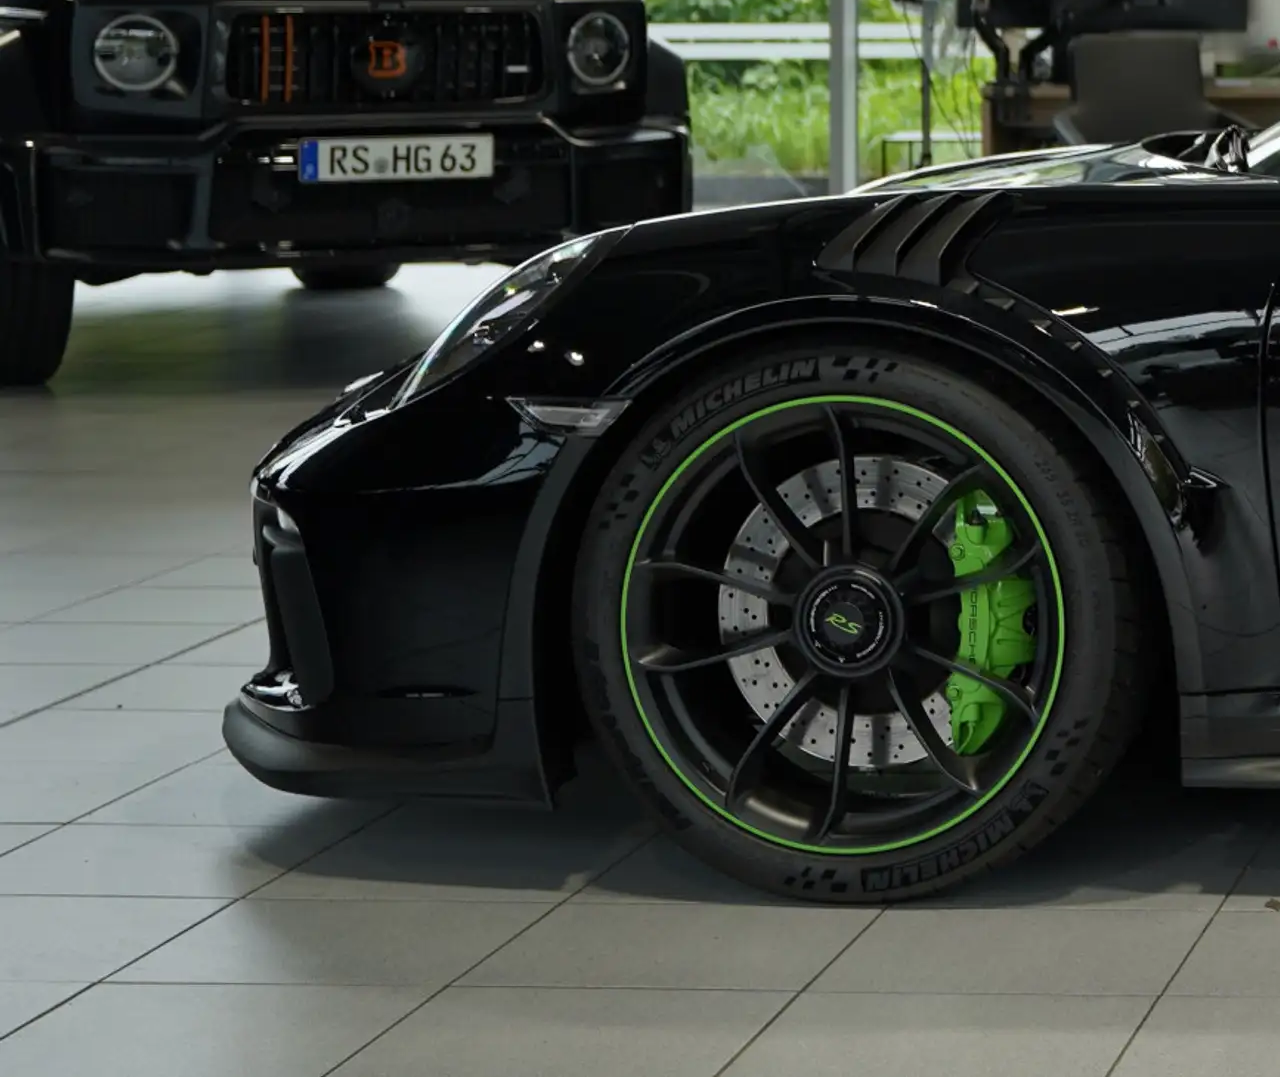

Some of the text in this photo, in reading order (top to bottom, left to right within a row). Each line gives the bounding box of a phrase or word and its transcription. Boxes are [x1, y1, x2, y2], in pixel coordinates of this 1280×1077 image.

[329, 142, 477, 175] RS HG 63
[671, 358, 818, 437] MICHELIN
[824, 611, 863, 635] RS
[866, 813, 1017, 892] MICHELIN
